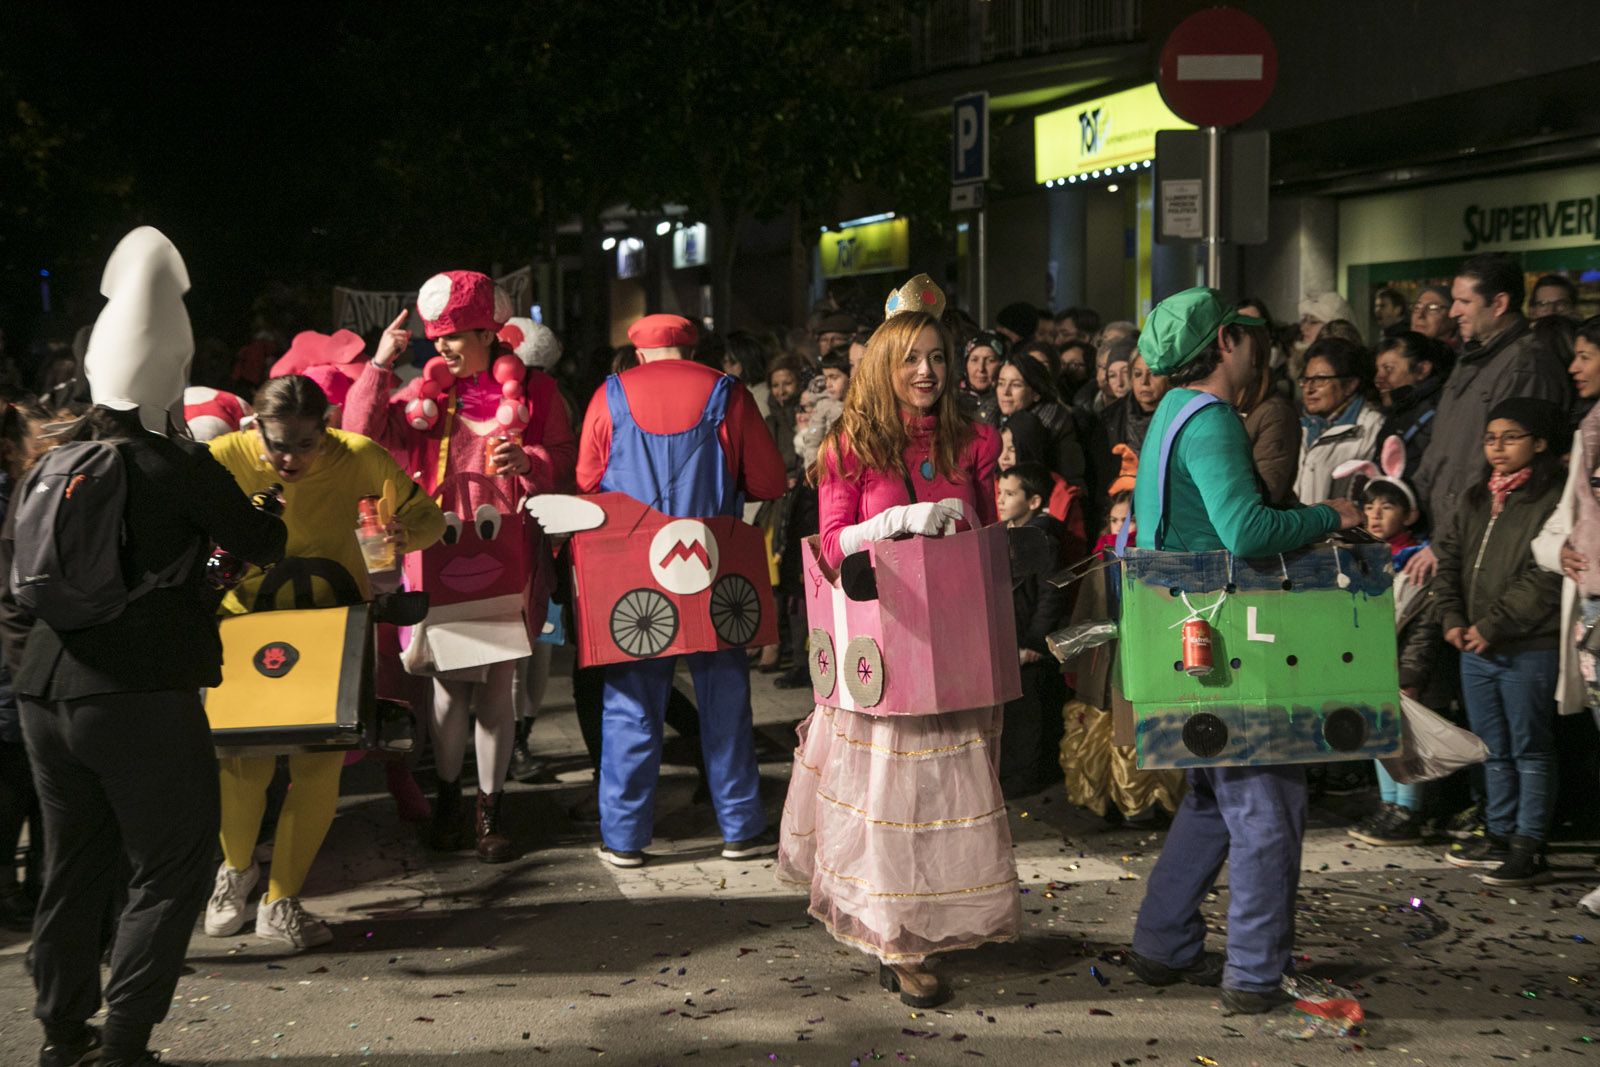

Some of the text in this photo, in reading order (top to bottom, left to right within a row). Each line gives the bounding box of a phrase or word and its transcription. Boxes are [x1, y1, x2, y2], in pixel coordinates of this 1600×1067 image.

[958, 104, 979, 173] P
[658, 538, 712, 571] M
[1246, 605, 1276, 643] L
